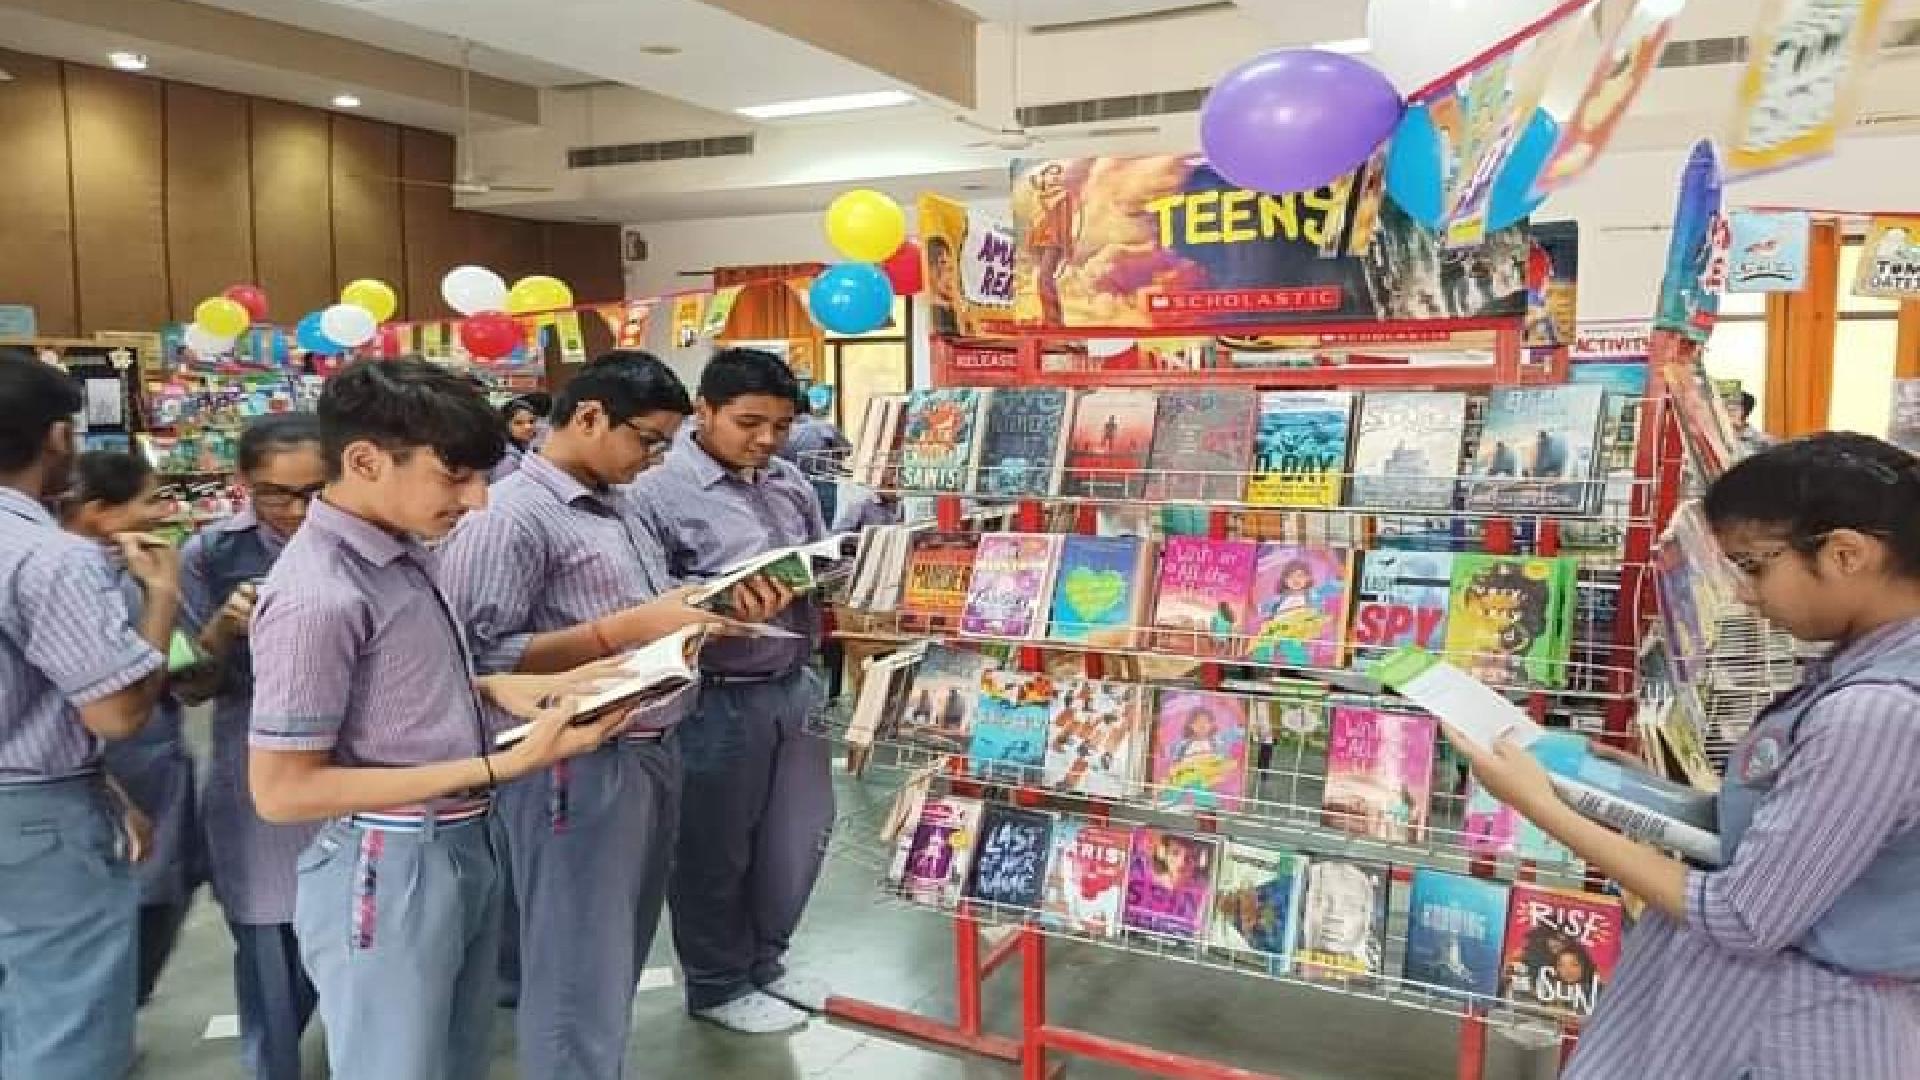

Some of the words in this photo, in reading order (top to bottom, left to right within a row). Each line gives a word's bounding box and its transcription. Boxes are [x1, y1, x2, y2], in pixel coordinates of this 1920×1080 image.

[1147, 186, 1344, 247] TEENS
[1172, 290, 1333, 311] SCHOLASTIC
[1356, 603, 1444, 648] SPY
[985, 822, 1043, 853] LAST
[1528, 901, 1606, 949] RISE
[1535, 965, 1601, 1016] SUN
